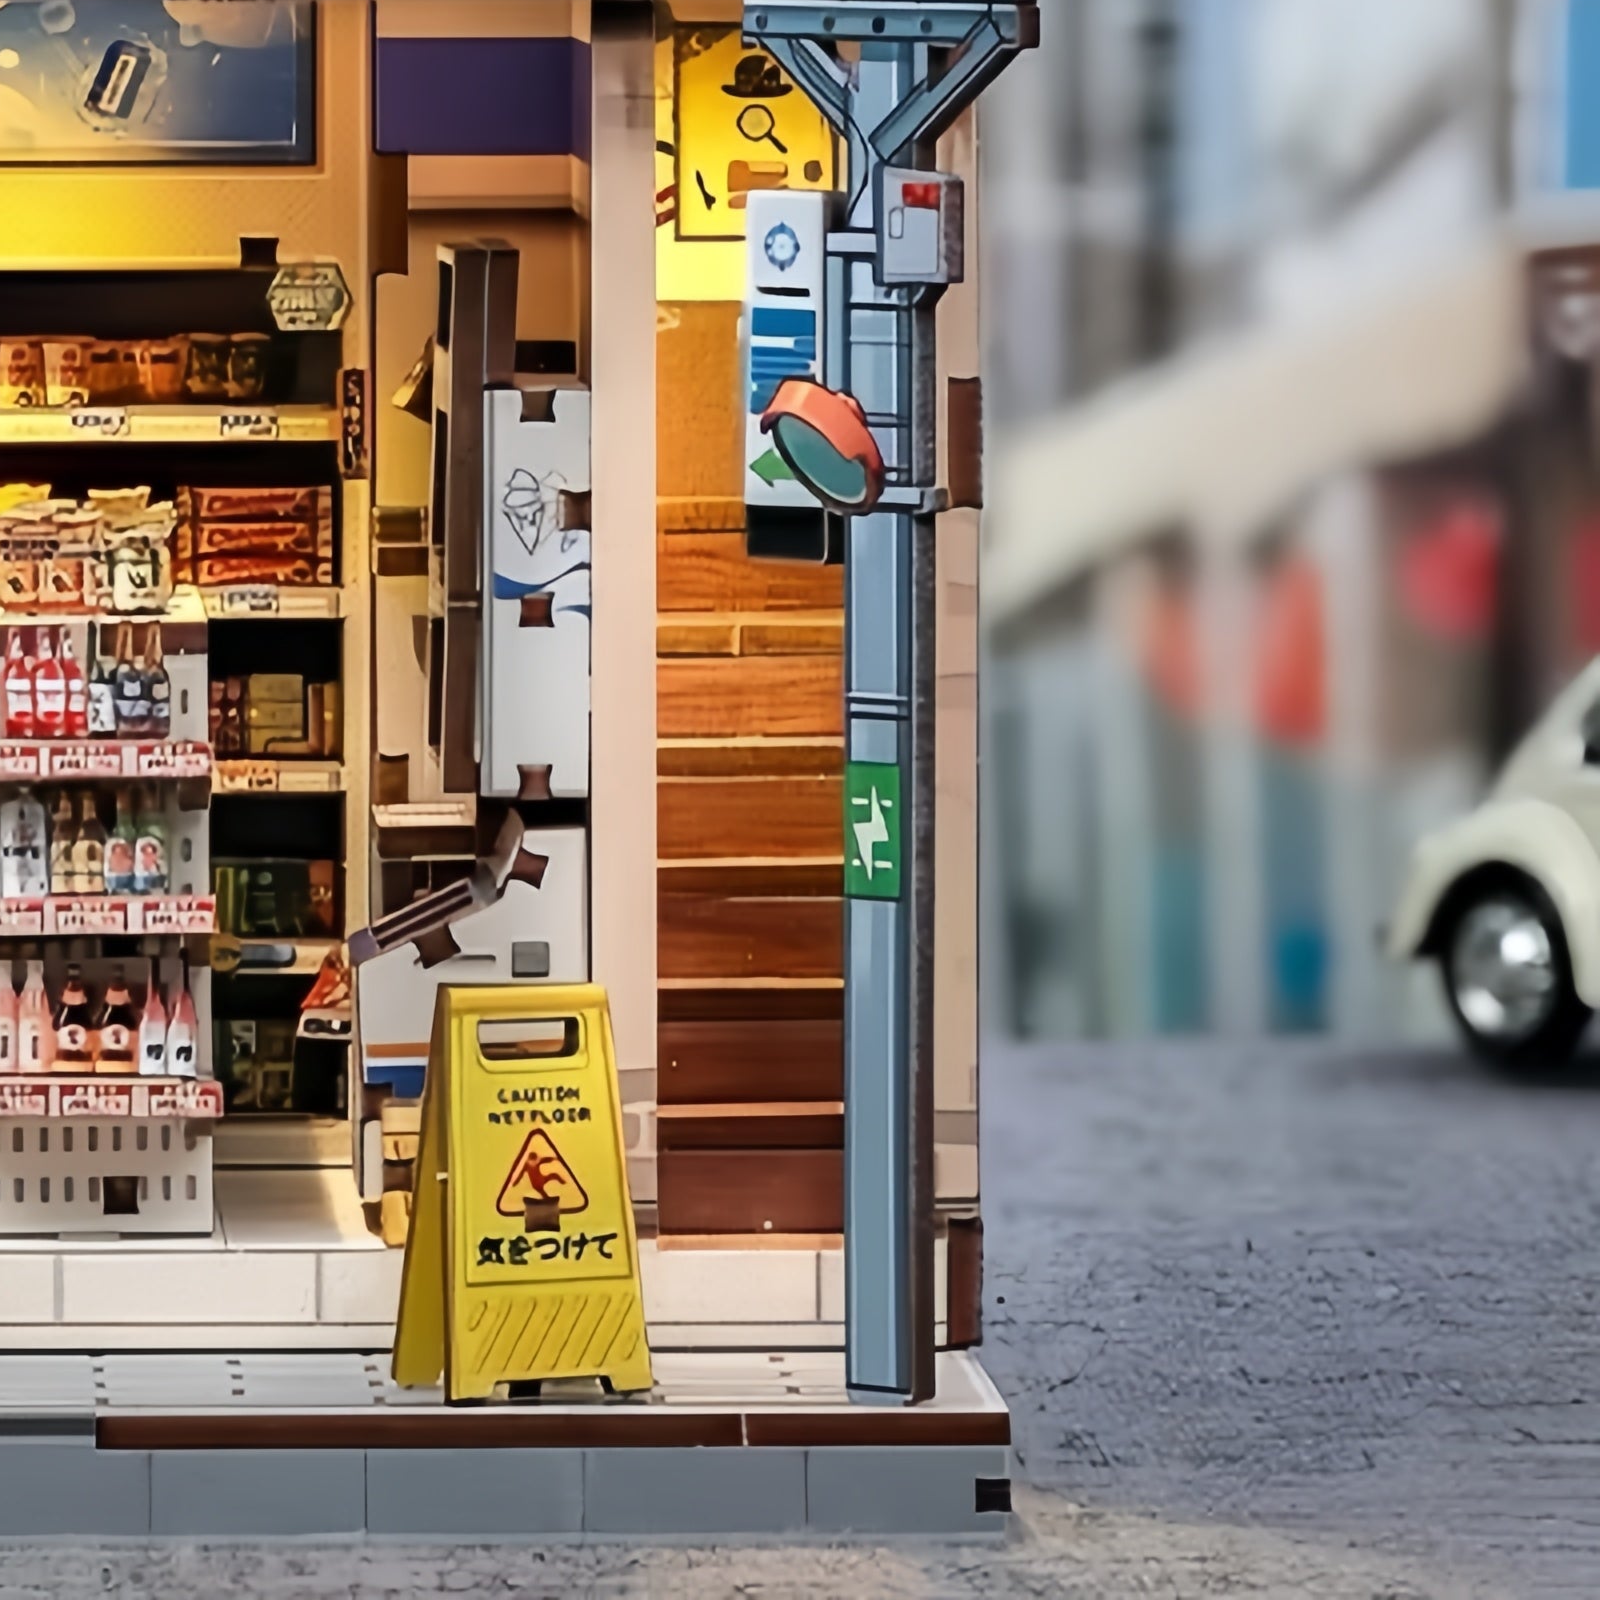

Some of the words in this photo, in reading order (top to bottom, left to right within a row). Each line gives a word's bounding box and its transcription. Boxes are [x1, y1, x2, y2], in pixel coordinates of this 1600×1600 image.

[476, 1232, 618, 1266] 気をつけて
